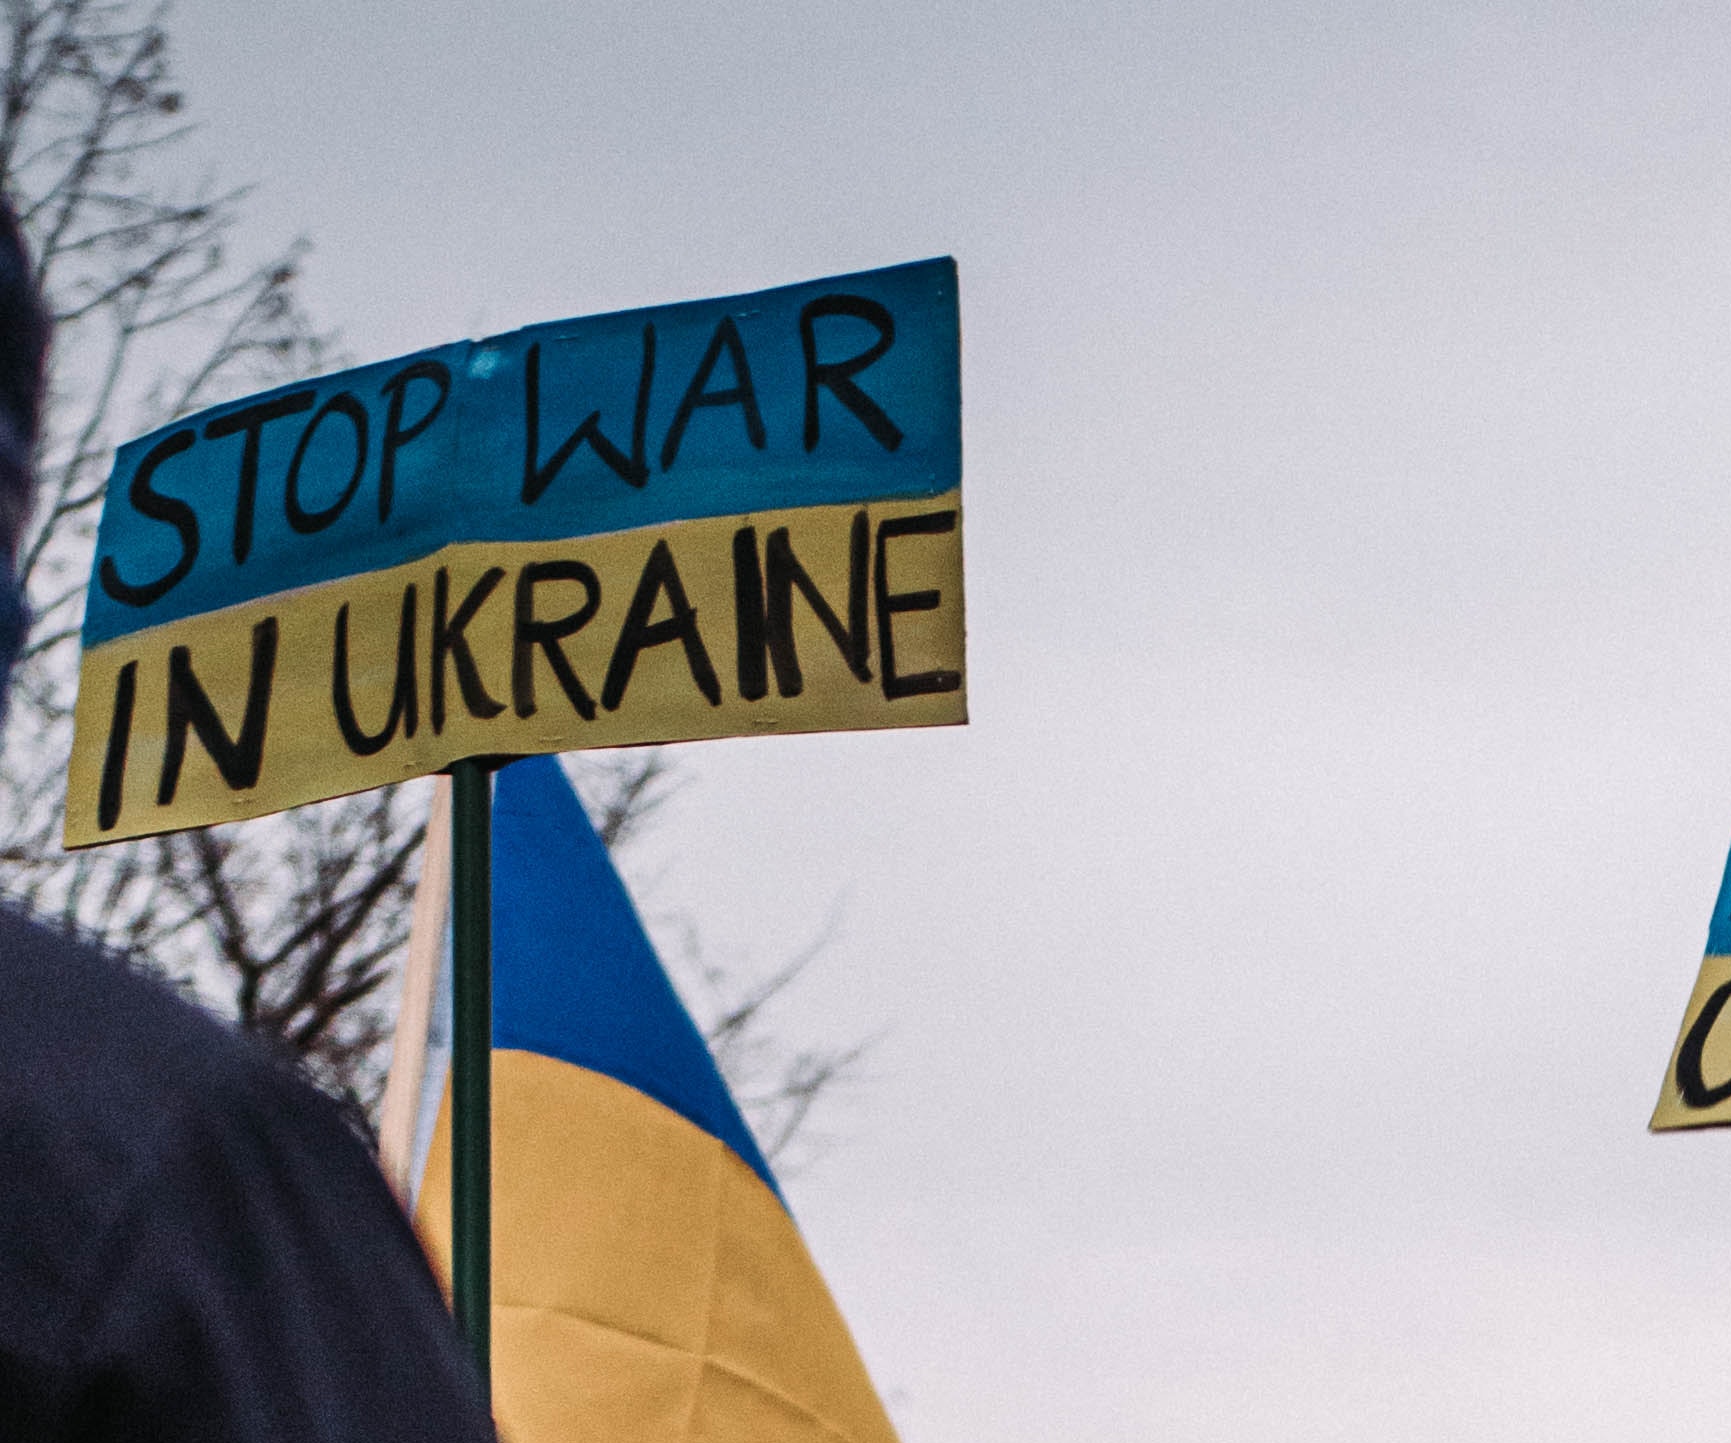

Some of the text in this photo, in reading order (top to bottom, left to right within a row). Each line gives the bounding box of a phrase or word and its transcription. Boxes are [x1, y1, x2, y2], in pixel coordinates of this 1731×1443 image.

[97, 292, 905, 607] STOP WAR
[97, 510, 963, 832] IN UKRAINE
